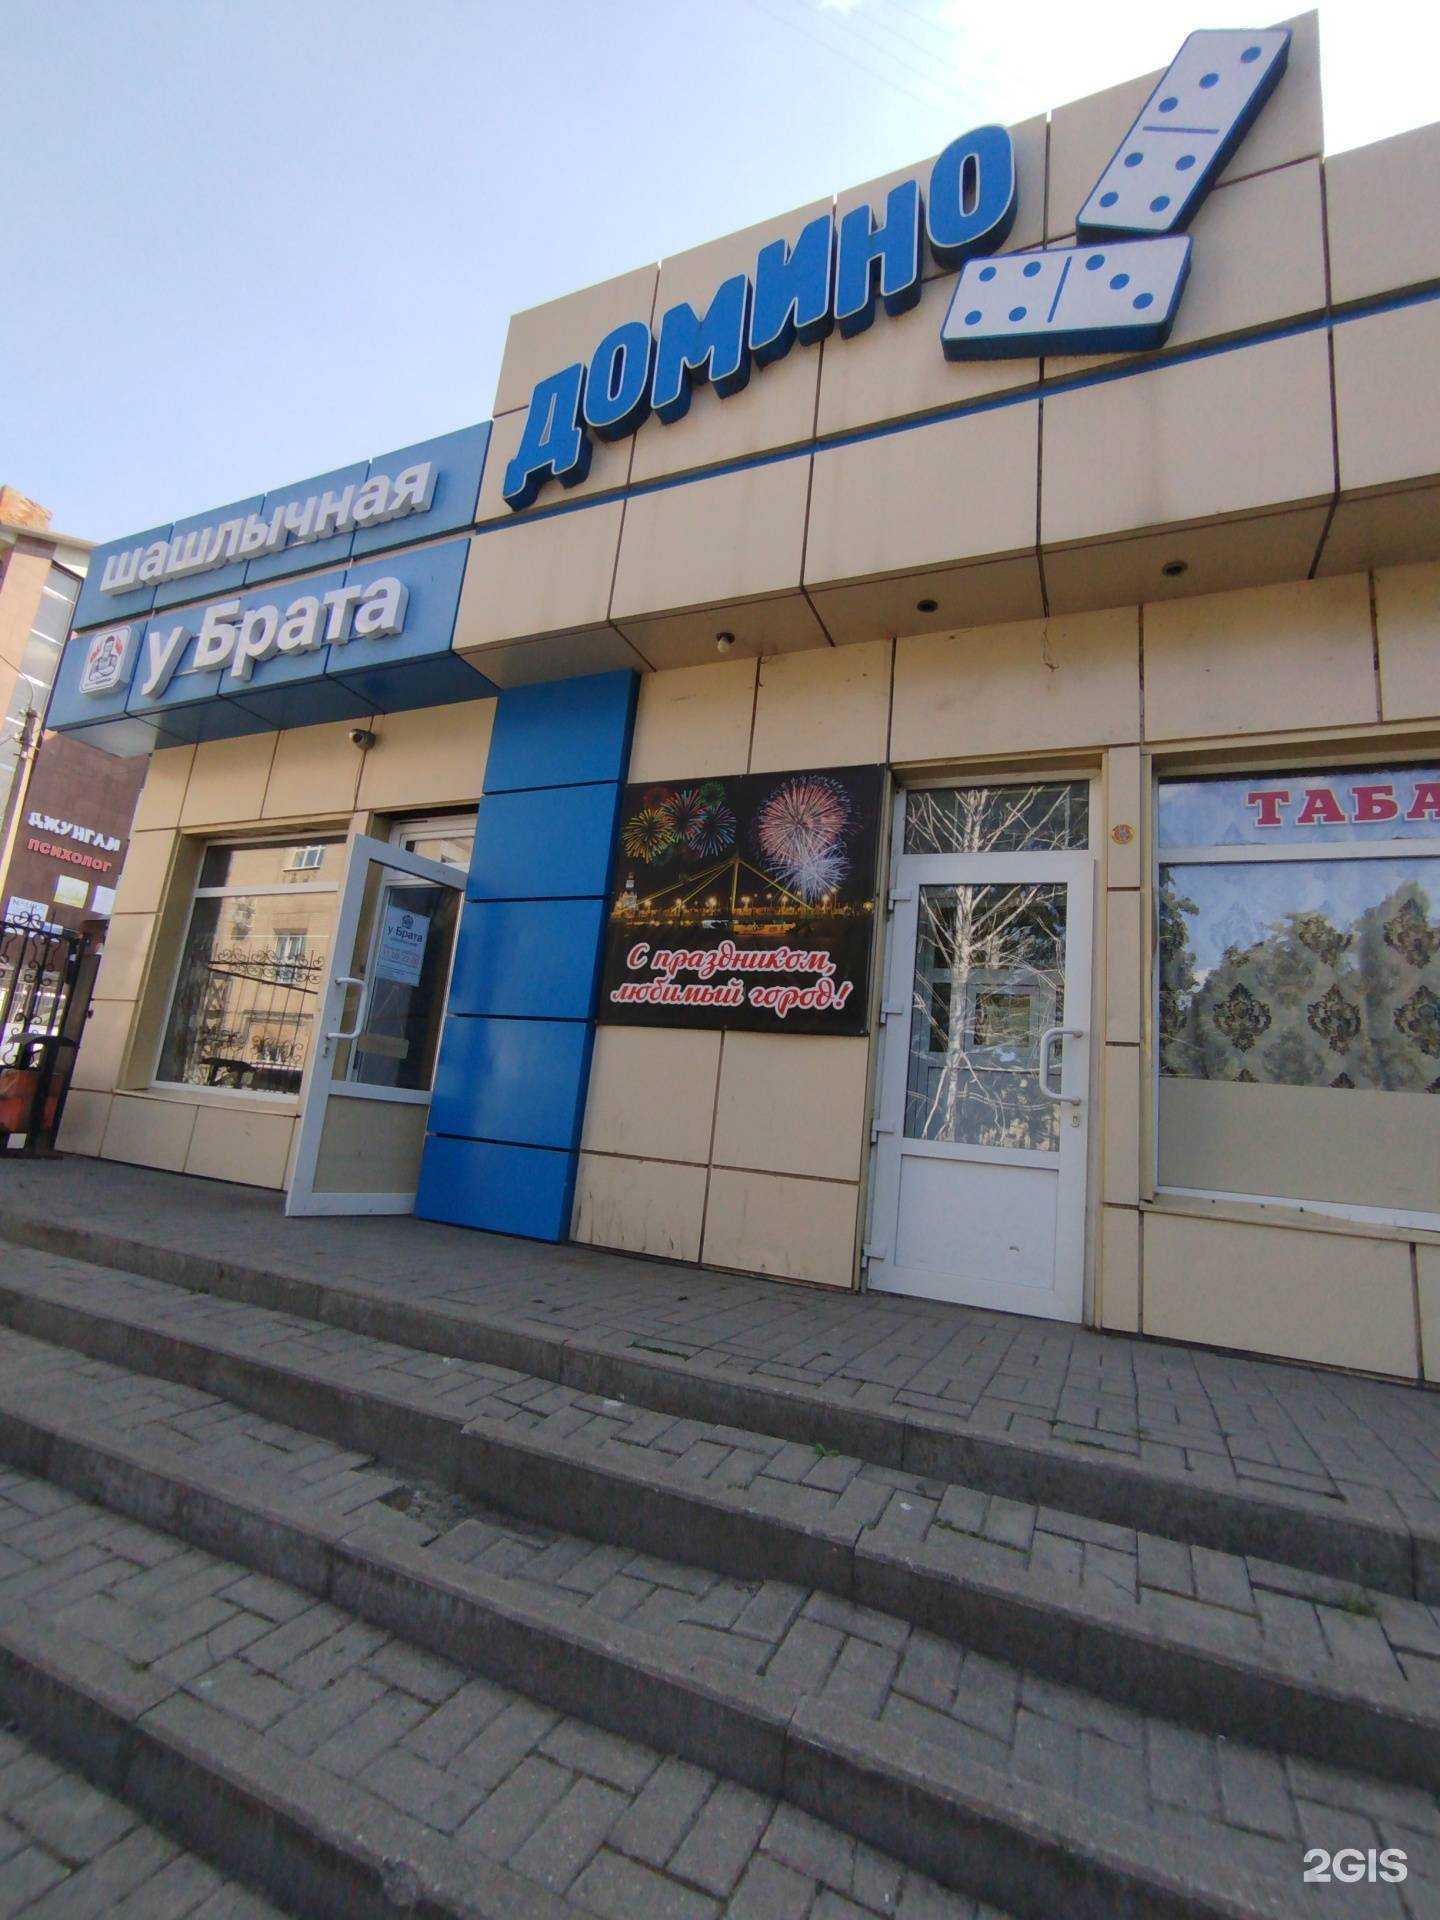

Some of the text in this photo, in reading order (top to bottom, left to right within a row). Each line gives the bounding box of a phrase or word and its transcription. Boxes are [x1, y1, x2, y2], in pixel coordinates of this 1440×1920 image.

[503, 123, 1017, 508] ДОМИНО
[193, 576, 408, 680] Брата
[1247, 781, 1440, 827] ТАБА
[627, 940, 836, 979] С праздником,
[611, 976, 853, 1018] любимый город!
